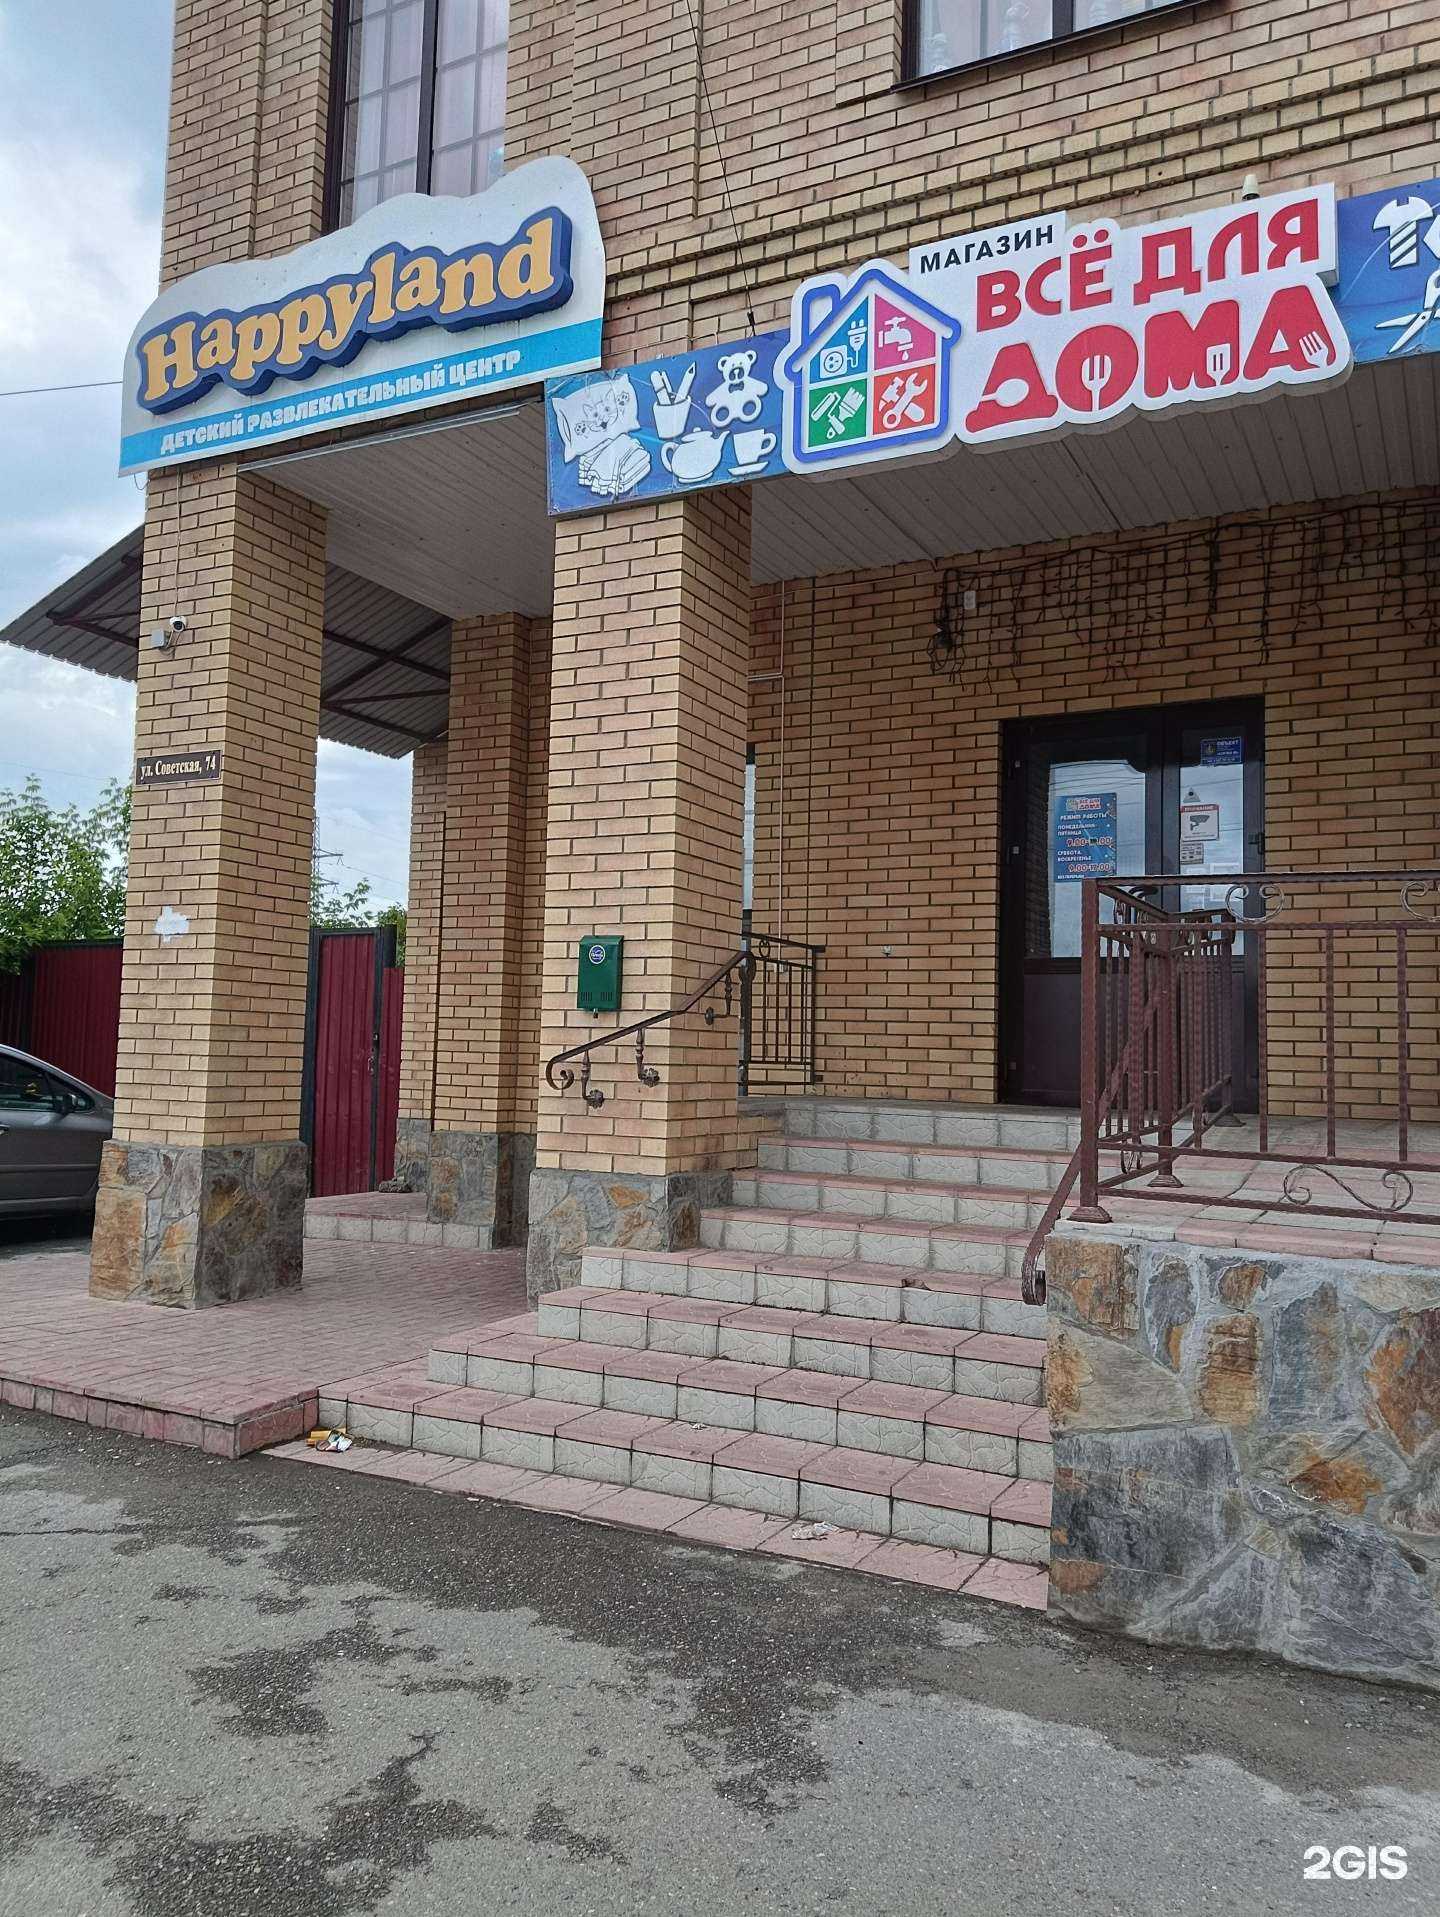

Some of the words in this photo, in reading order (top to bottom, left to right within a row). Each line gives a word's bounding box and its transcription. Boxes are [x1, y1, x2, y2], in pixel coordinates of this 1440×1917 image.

[142, 216, 556, 402] Happyland
[920, 224, 1054, 274] МАГАЗИН
[976, 229, 1112, 333] ВСЁ
[1133, 198, 1320, 305] ДЛЯ
[160, 415, 245, 456] ДЕТСКИЙ
[247, 369, 446, 434] РАЗВЛЕКАТЕЛЬНЫЙ
[449, 349, 522, 388] ЦЕНТР
[965, 284, 1337, 434] ДОМА
[140, 764, 154, 780] ул.
[155, 760, 203, 776] Советская,
[205, 755, 216, 771] 74
